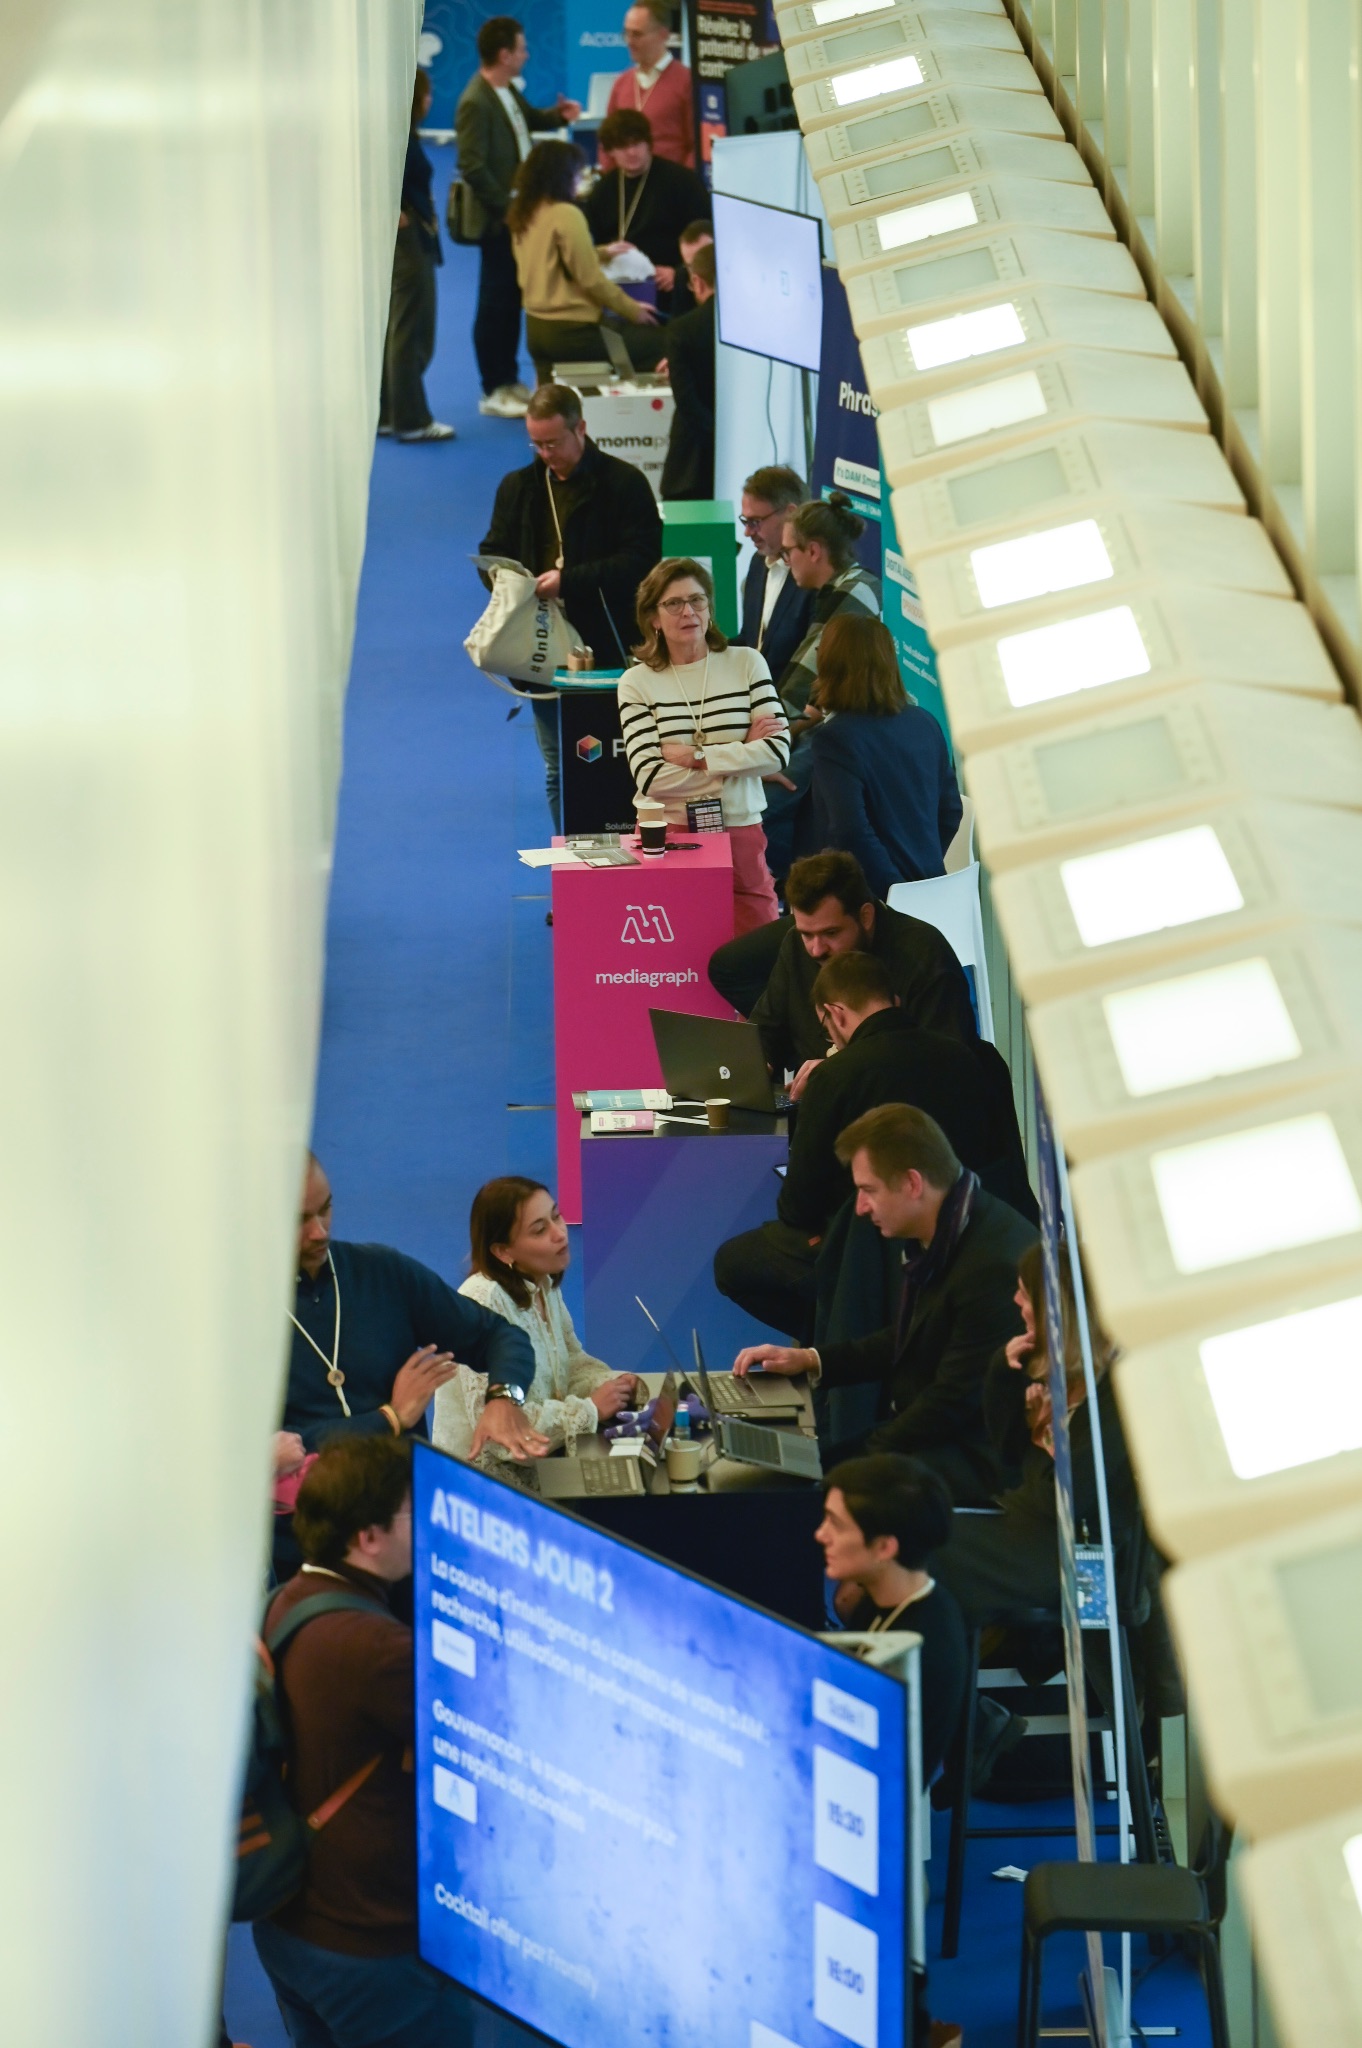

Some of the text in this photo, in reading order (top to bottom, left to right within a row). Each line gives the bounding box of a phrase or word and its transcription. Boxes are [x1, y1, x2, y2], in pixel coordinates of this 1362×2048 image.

[595, 967, 699, 988] mediagraph
[430, 1487, 615, 1614] ATELIERS JOUR 2
[431, 1552, 449, 1581] La
[449, 1563, 499, 1606] couche
[499, 1587, 588, 1654] d'intelligence
[431, 1589, 503, 1644] recherche,
[432, 1698, 524, 1764] Gouvernance
[432, 1733, 461, 1765] une
[434, 1881, 490, 1932] Cocktail
